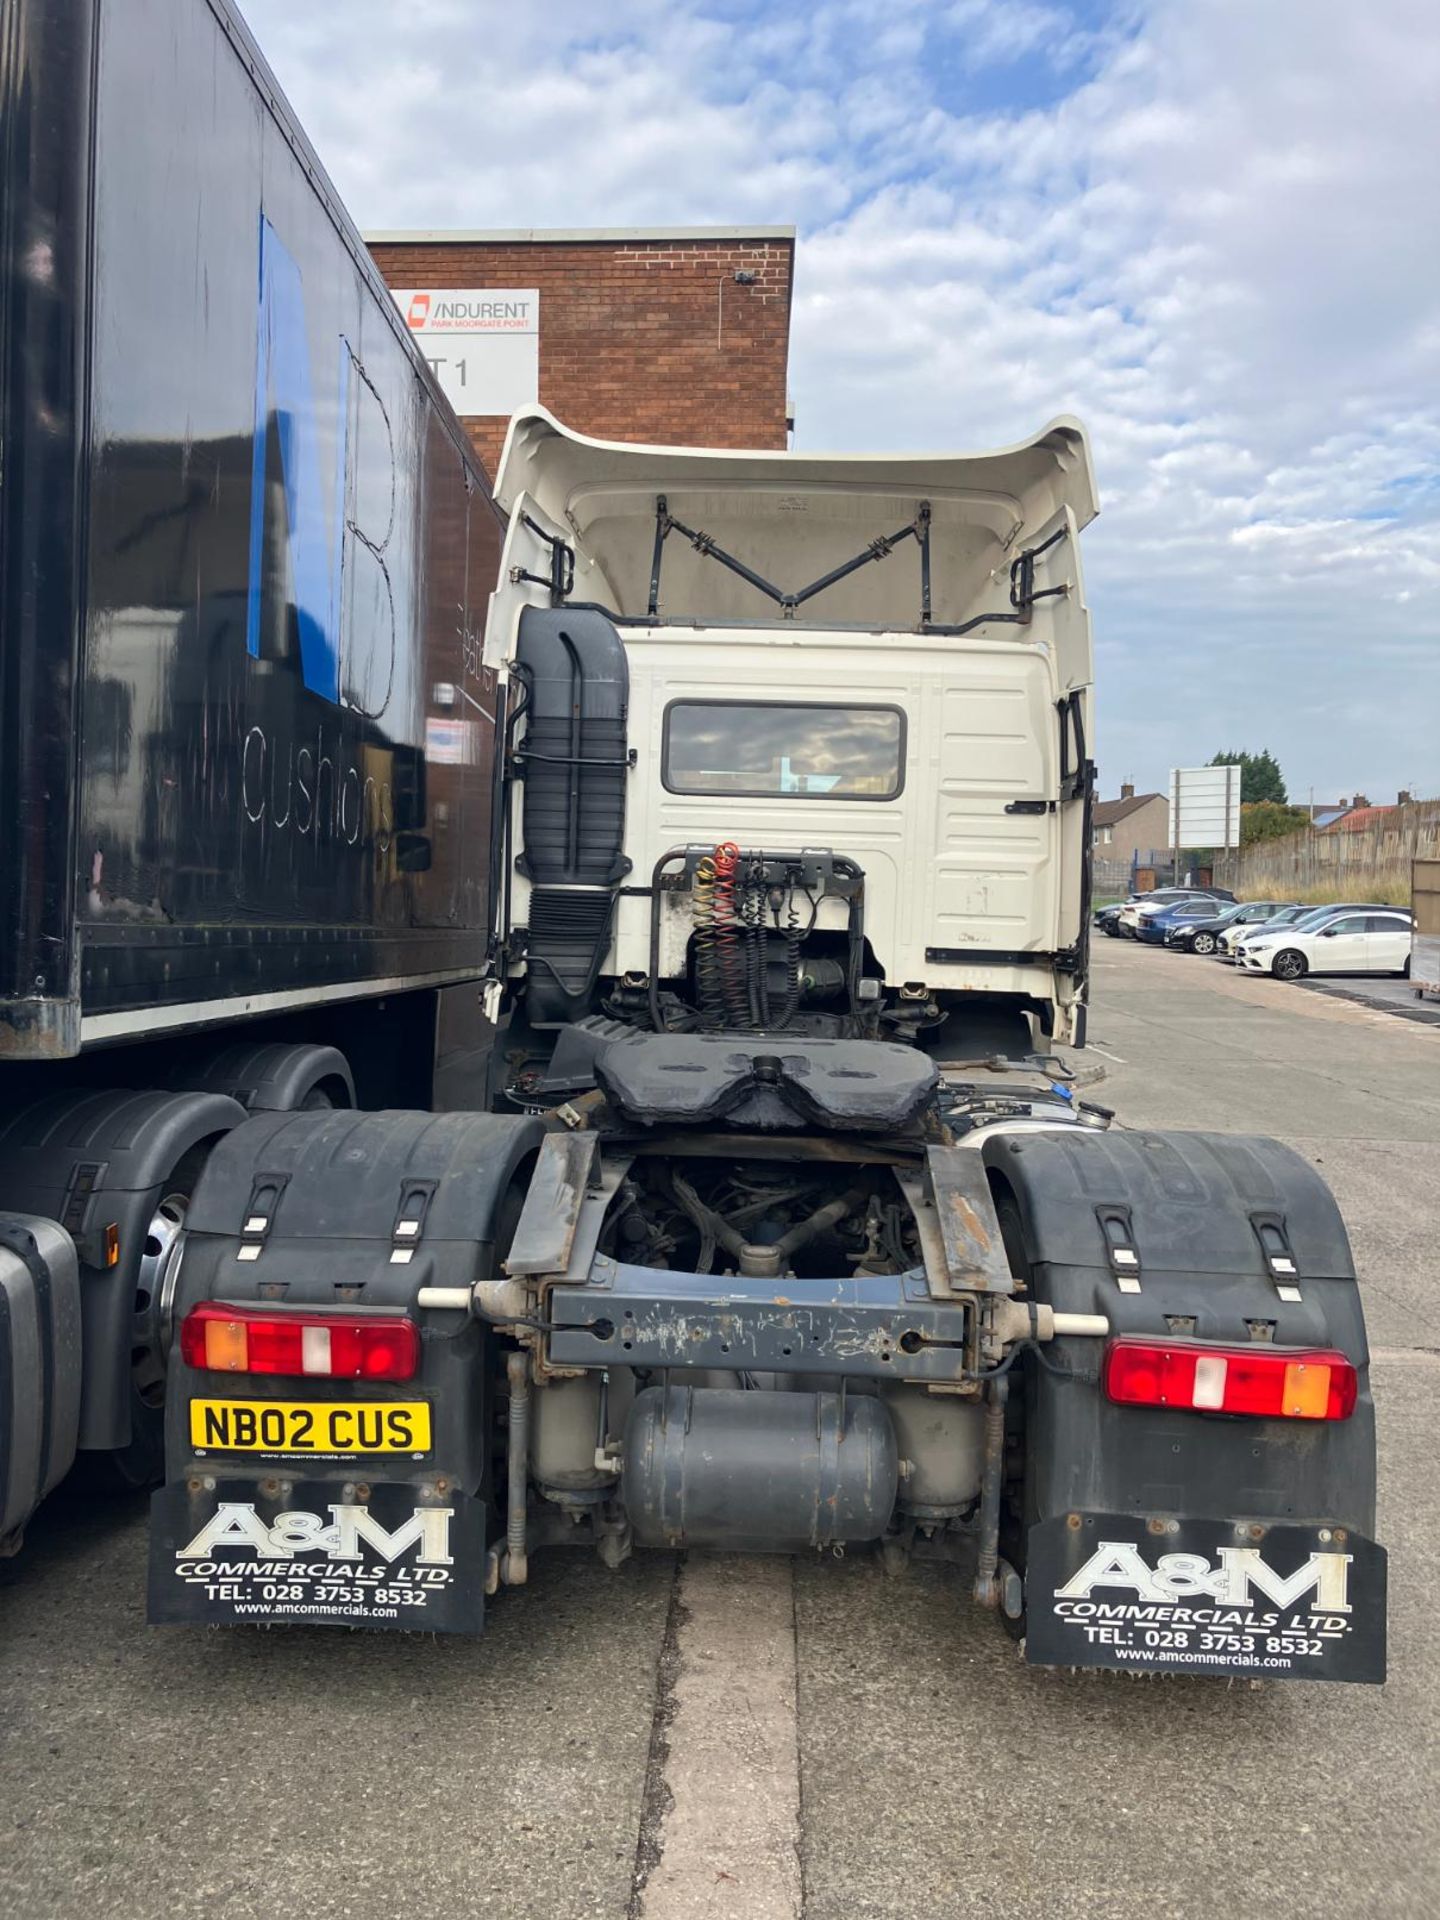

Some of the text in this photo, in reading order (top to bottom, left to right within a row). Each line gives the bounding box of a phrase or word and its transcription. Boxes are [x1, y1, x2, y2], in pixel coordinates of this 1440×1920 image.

[431, 319, 529, 328] PARK MOORGATE POINT
[455, 358, 466, 386] 1
[205, 1407, 414, 1449] NB02 CUS
[176, 1502, 455, 1565] A&M
[174, 1562, 454, 1582] COMMERCIALS LTD.
[1053, 1541, 1354, 1613] A&M
[204, 1584, 427, 1606] TEL: 028 3753 8532
[234, 1604, 398, 1618] www.amcommercials.com
[1053, 1602, 1353, 1632] COMMERCIALS LTD.
[1084, 1626, 1323, 1656] TEL: 028 3753 8532
[1115, 1649, 1292, 1669] www.amcommercials.com
